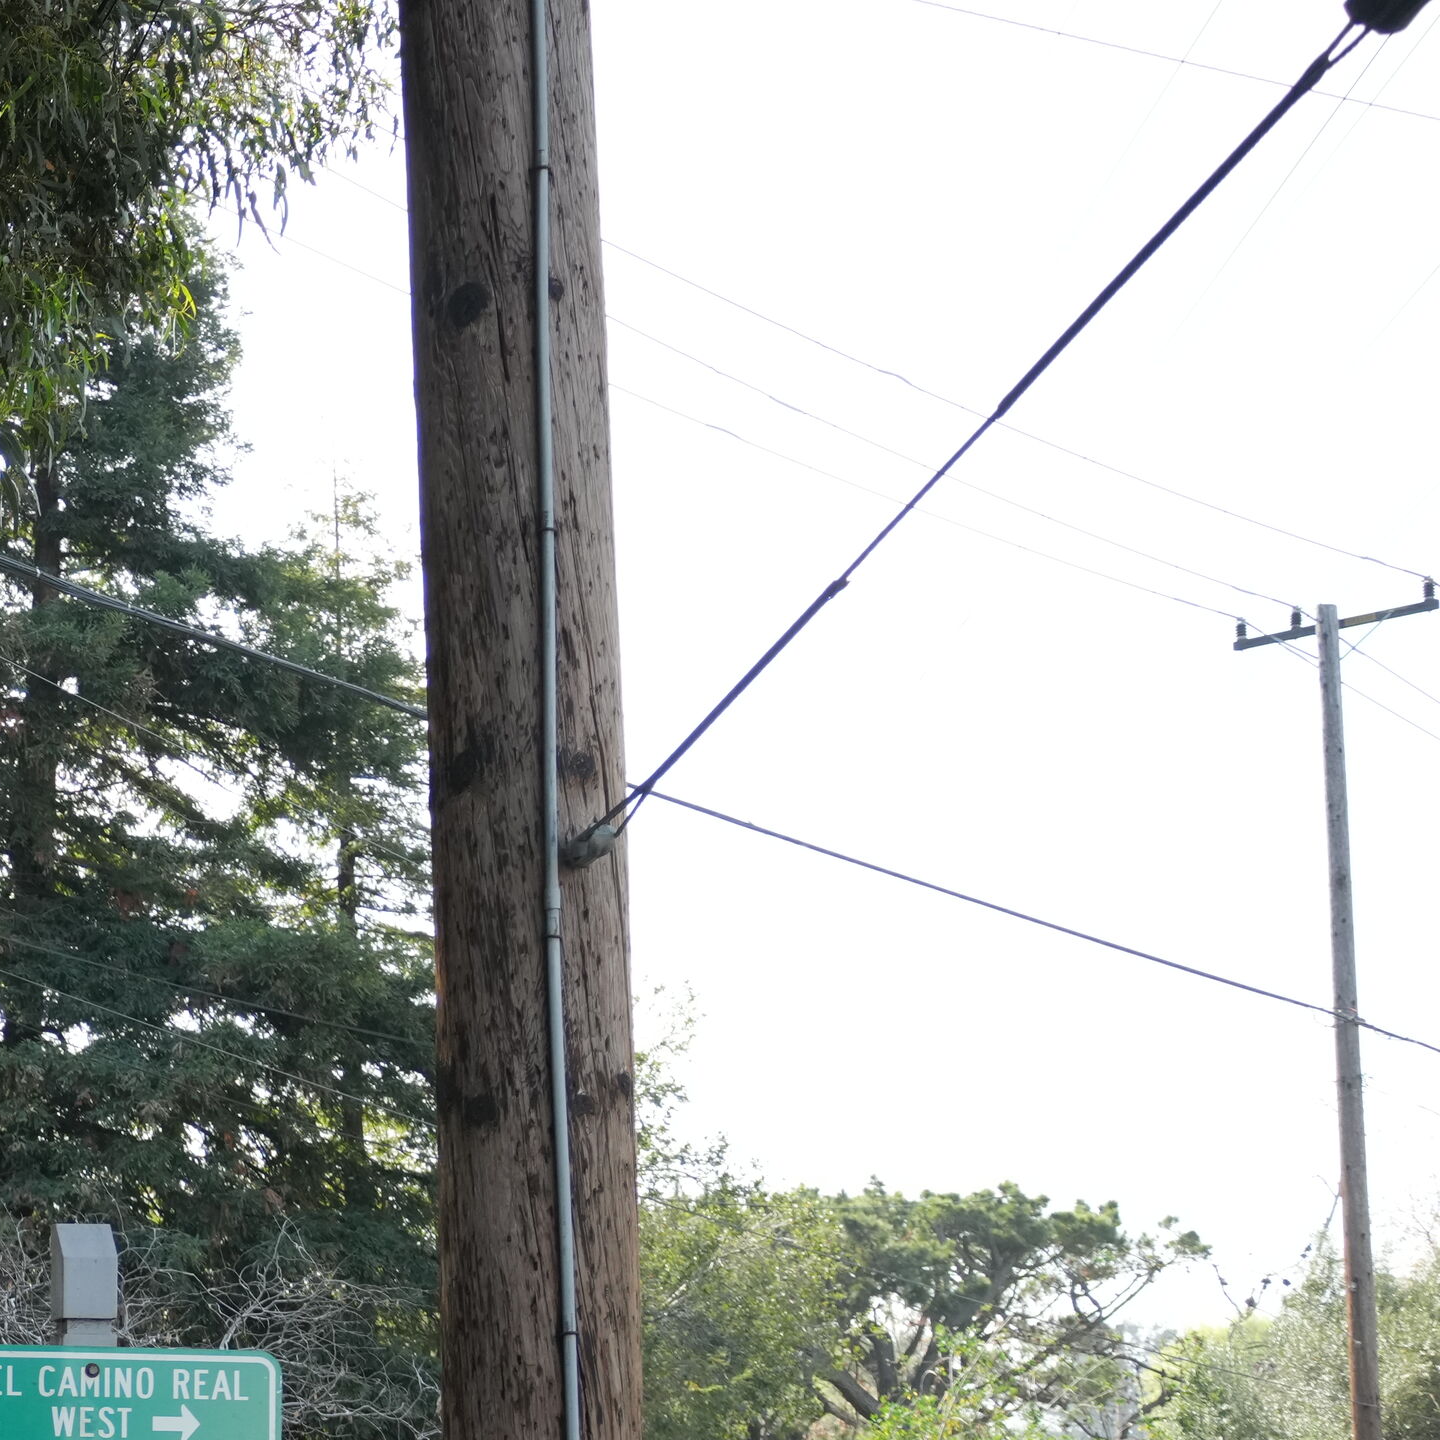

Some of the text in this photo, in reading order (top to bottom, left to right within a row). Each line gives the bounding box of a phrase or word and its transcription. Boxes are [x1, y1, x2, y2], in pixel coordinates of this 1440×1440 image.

[38, 1366, 154, 1399] CAMINO
[172, 1369, 249, 1401] REAL
[52, 1406, 132, 1438] WEST
